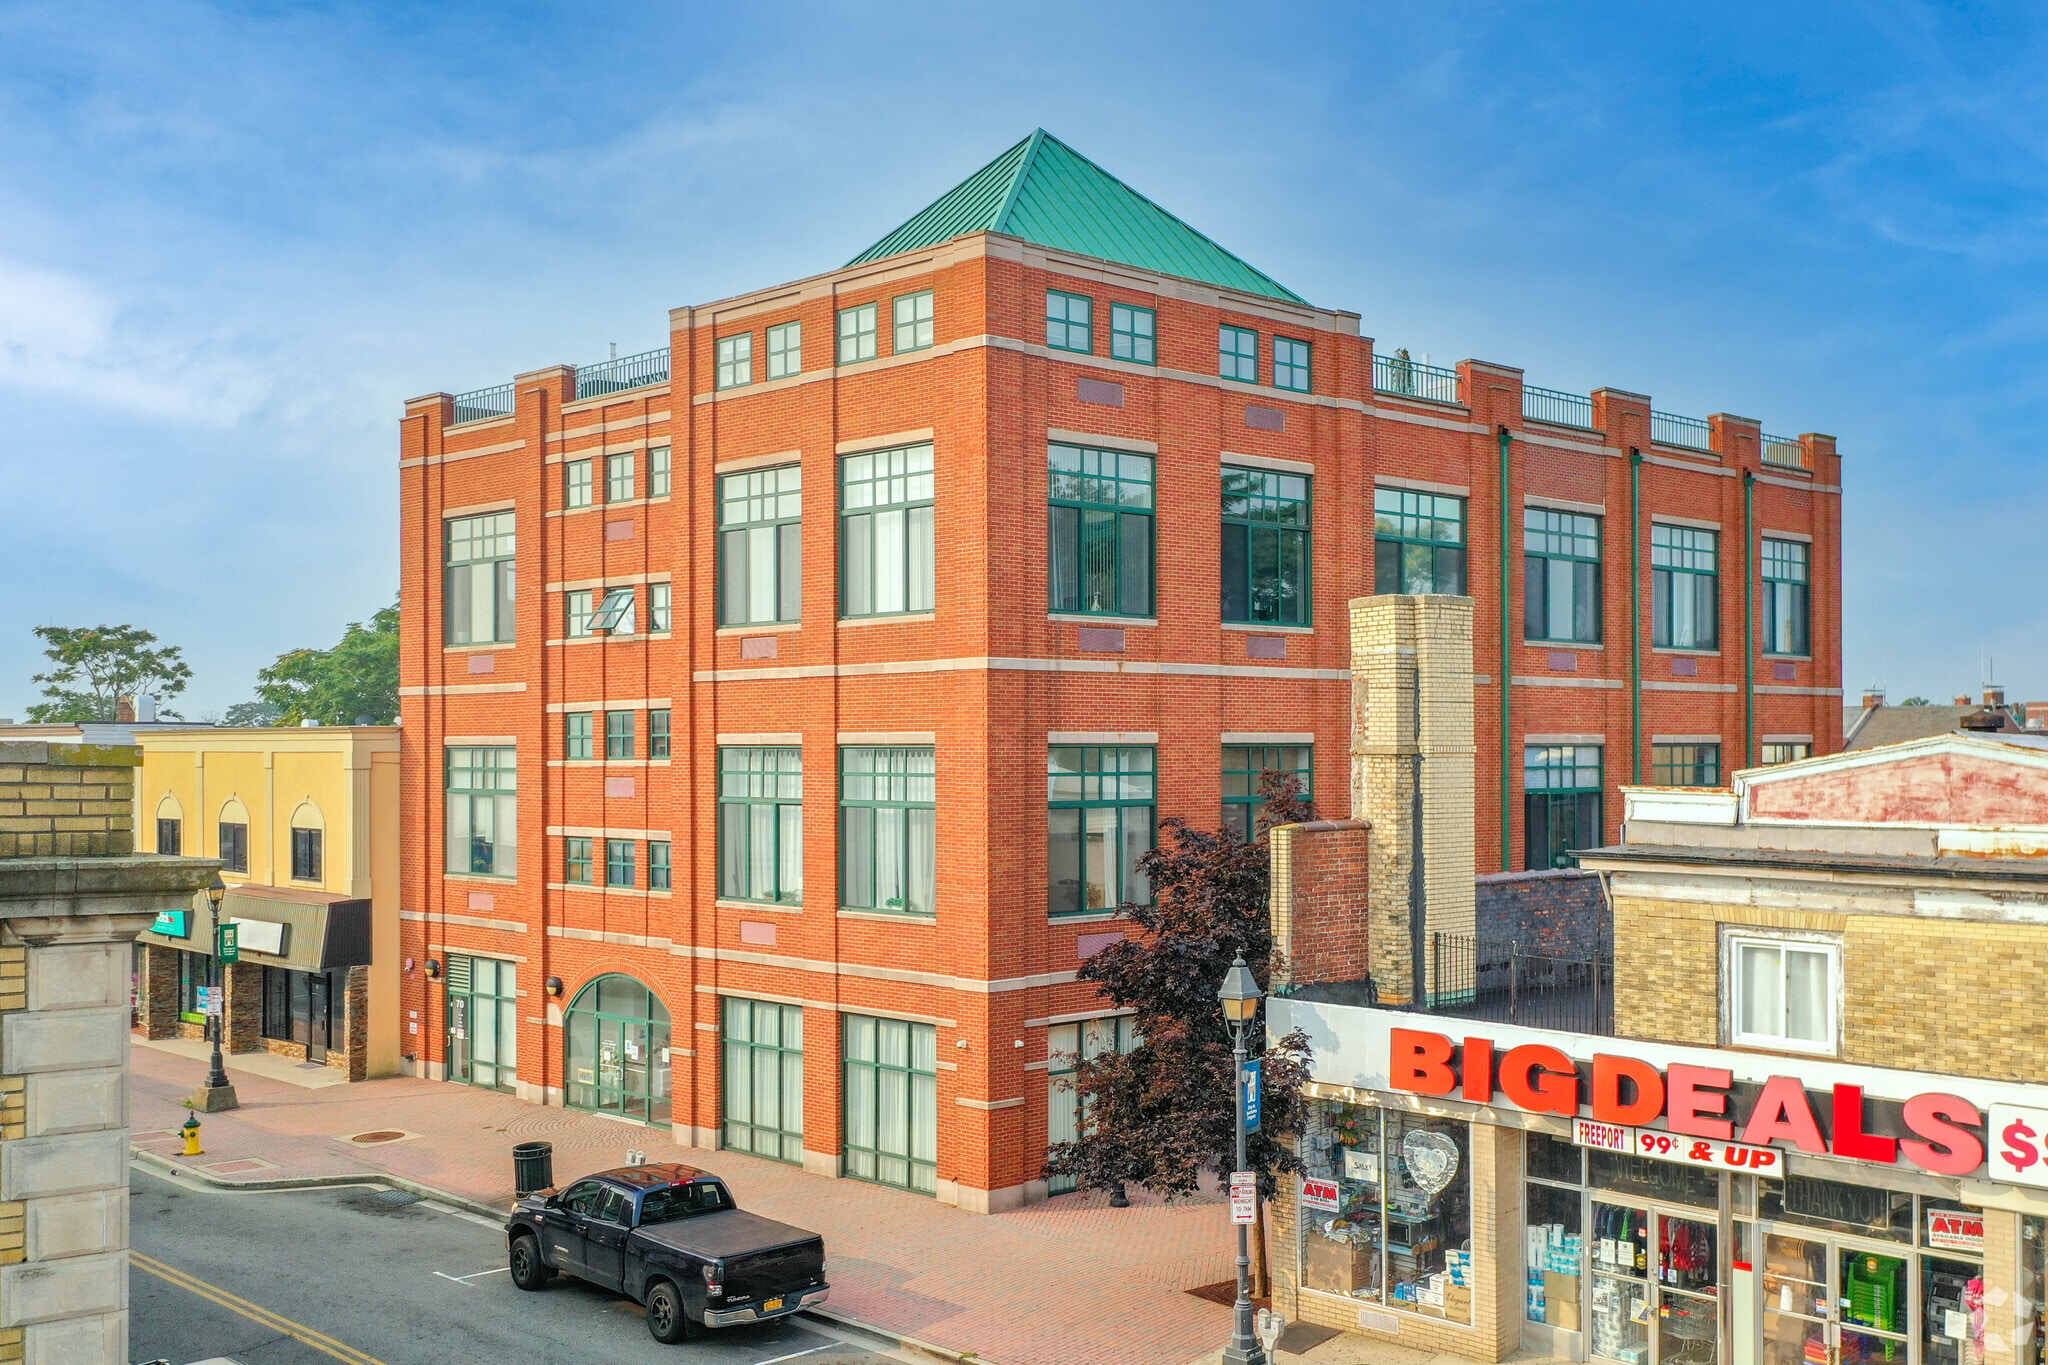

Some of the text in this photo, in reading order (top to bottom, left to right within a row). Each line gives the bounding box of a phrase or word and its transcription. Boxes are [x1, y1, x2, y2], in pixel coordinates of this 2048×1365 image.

[456, 1000, 465, 1009] 70
[1389, 1027, 1985, 1176] BIG DEALS
[1579, 1122, 1625, 1150] FREEPORT
[1640, 1132, 1776, 1169] 99¢ & UP
[1303, 1183, 1338, 1201] ATM
[1932, 1217, 1984, 1237] ATM
[1932, 1232, 1964, 1241] AVAILABLE
